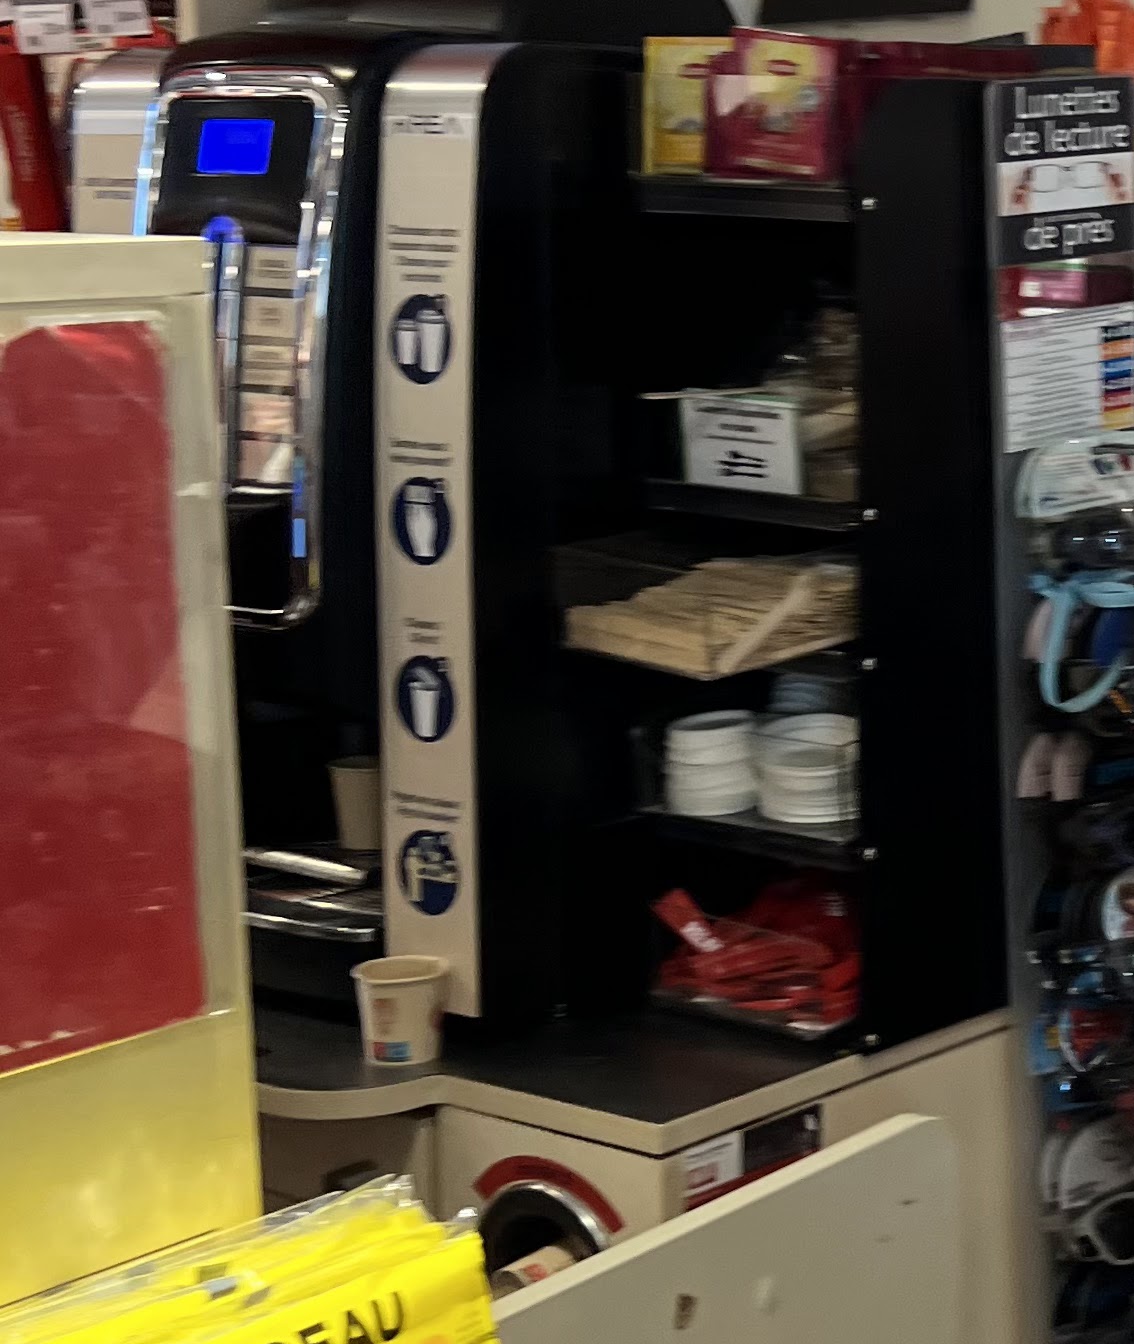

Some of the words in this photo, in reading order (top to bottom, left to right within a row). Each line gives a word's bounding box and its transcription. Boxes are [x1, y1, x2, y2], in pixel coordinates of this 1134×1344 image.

[1013, 86, 1122, 119] Lunettes
[1003, 122, 1041, 156] de
[1044, 120, 1131, 153] lecture
[1023, 216, 1060, 251] de
